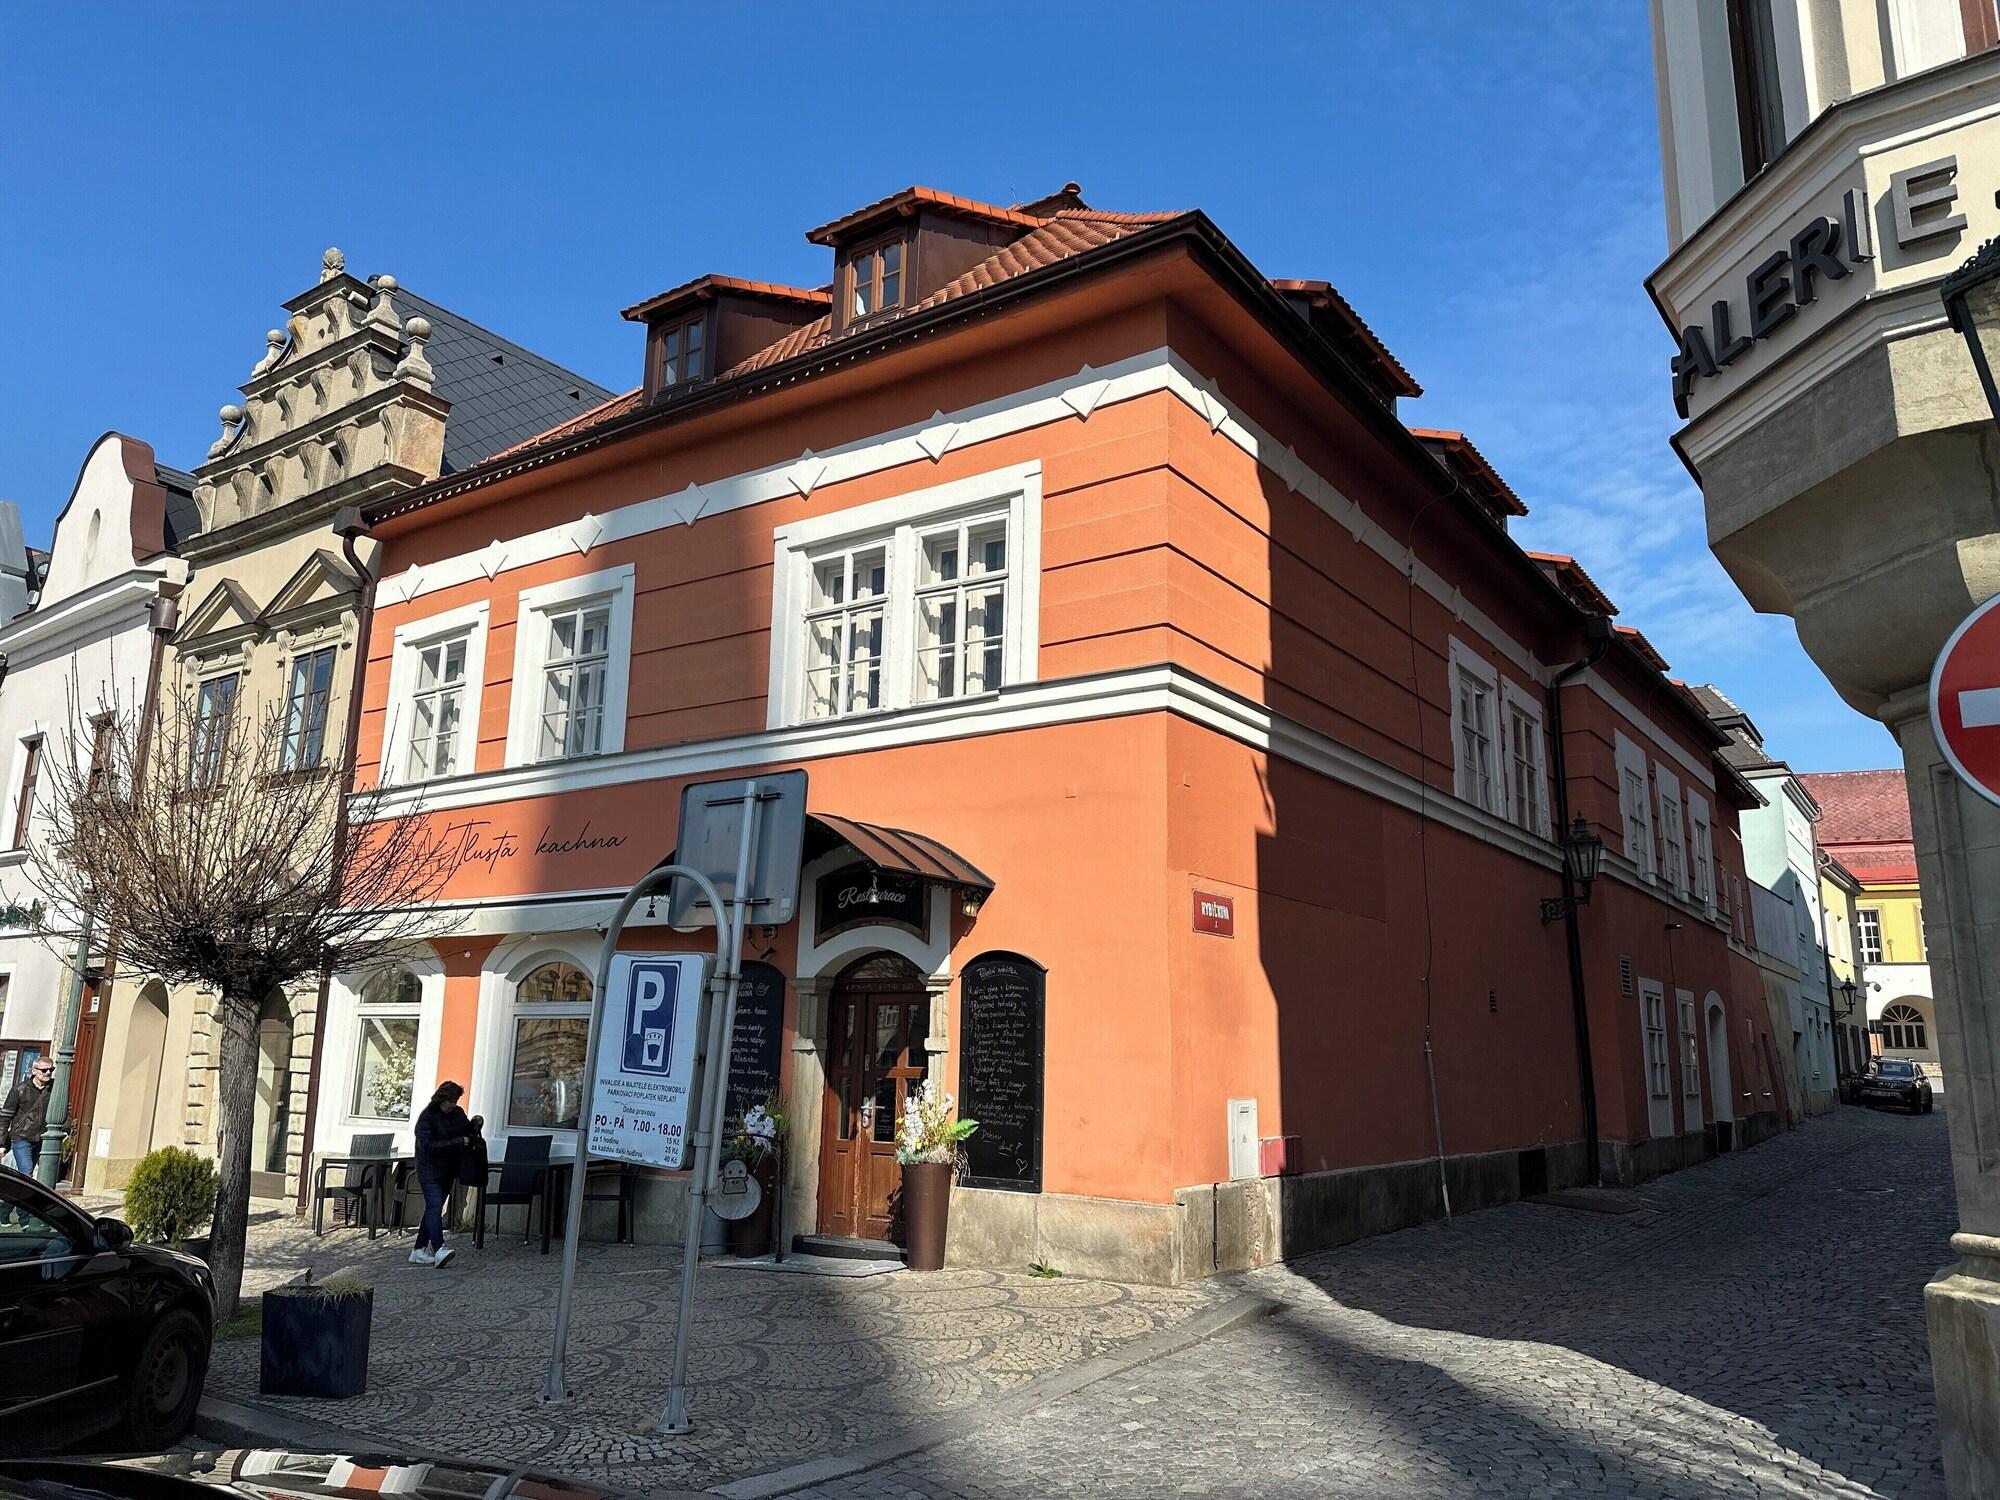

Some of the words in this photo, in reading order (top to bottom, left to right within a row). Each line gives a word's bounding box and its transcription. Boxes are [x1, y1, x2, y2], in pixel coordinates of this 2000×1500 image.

[448, 819, 519, 877] Tlustá
[534, 820, 628, 856] kachna
[838, 886, 907, 909] Resturace
[632, 970, 666, 1035] P
[633, 1091, 657, 1101] POPLATEK
[622, 1106, 636, 1114] Doba
[636, 1108, 656, 1117] provozu
[594, 1114, 608, 1126] PO
[613, 1115, 625, 1129] PÁ
[633, 1119, 651, 1133] 7.00
[658, 1123, 682, 1137] 18.00
[600, 1127, 615, 1136] minut
[672, 1137, 680, 1146] Kč
[603, 1136, 619, 1145] hodinu
[664, 1146, 671, 1154] 25
[671, 1146, 679, 1155] Kč
[597, 1144, 615, 1153] každou
